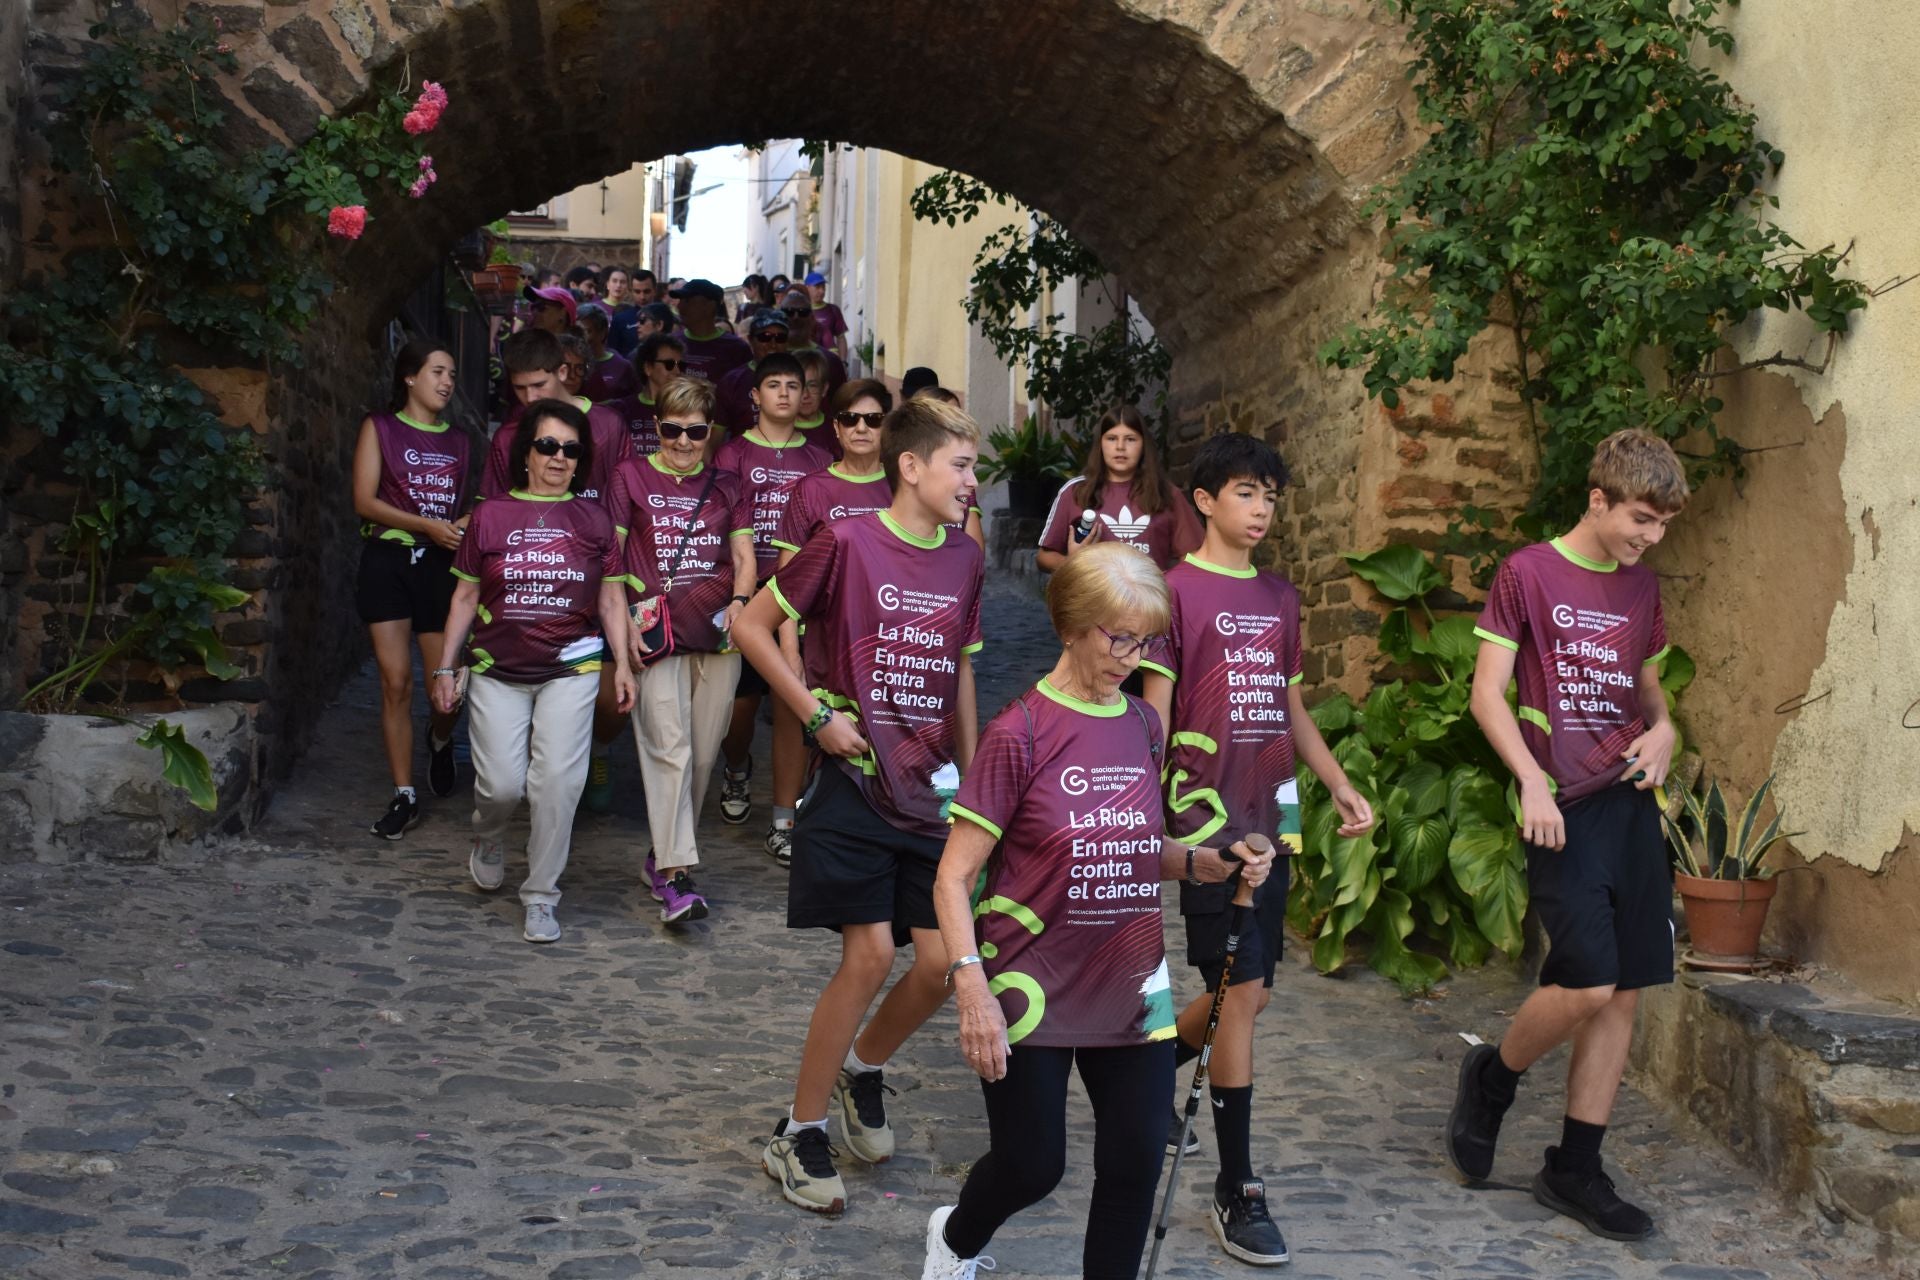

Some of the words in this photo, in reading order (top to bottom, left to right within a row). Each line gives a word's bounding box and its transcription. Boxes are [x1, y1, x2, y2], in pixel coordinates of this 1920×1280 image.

[408, 472, 422, 485] La
[755, 492, 768, 502] La
[652, 515, 670, 526] La
[654, 532, 671, 544] En
[505, 552, 524, 562] La
[528, 552, 565, 565] Rioja
[658, 559, 670, 572] el
[504, 568, 523, 580] En
[528, 568, 585, 582] marcha
[505, 582, 554, 592] contra
[902, 590, 934, 598] asociación
[504, 593, 517, 604] el
[520, 594, 572, 607] cáncer
[928, 600, 948, 608] cáncer
[918, 606, 934, 615] Rioja
[878, 622, 898, 641] La
[903, 626, 944, 648] Rioja
[875, 648, 894, 666] En
[1224, 648, 1242, 663] La
[1246, 647, 1275, 666] Rioja
[1556, 639, 1577, 654] La
[1581, 642, 1618, 663] Rioja
[1556, 662, 1578, 677] En
[872, 670, 925, 688] contra
[1228, 670, 1246, 686] En
[1250, 672, 1286, 688] march
[870, 686, 888, 702] el
[892, 689, 944, 710] cáncer
[1230, 688, 1274, 704] contra
[1560, 696, 1576, 711] el
[1230, 706, 1244, 722] el
[1090, 766, 1124, 774] asociación
[1113, 774, 1119, 782] el
[1120, 774, 1139, 782] cáncer
[1110, 782, 1126, 792] Rioja
[1070, 810, 1095, 828] La
[1100, 807, 1147, 830] Rioja
[1072, 838, 1096, 858] En
[1102, 835, 1162, 856] march
[1070, 860, 1132, 878] contra
[1068, 882, 1088, 900] el
[1094, 880, 1160, 900] cáncer
